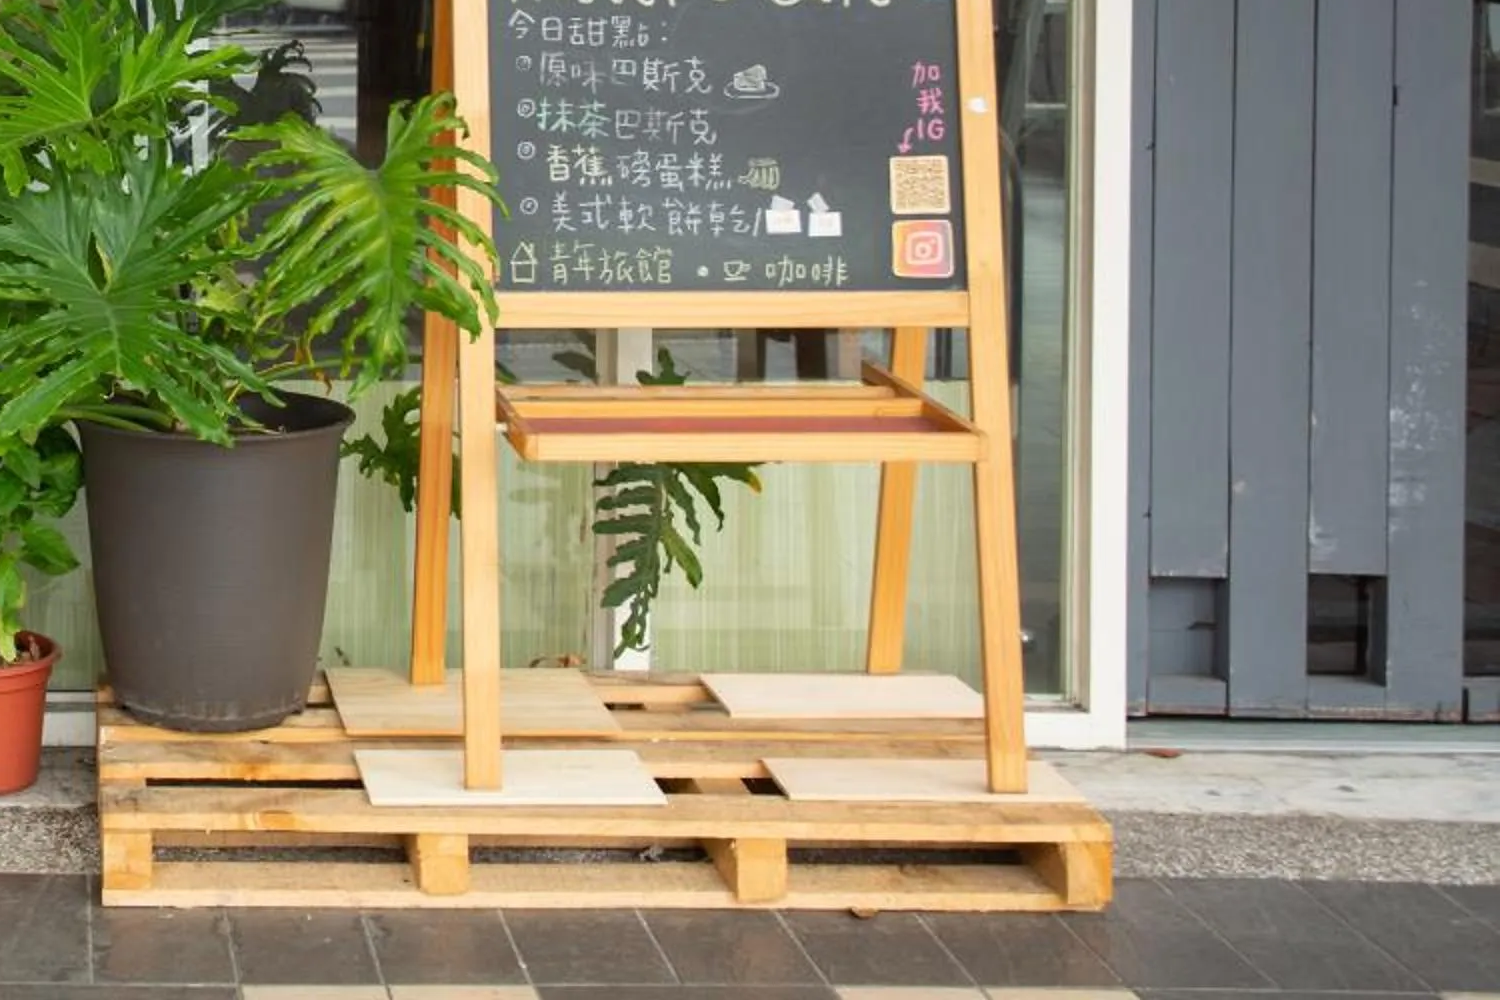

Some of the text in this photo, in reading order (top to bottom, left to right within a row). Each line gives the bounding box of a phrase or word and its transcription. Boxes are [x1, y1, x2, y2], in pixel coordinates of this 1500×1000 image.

[539, 50, 713, 95] 原味巴斯克
[535, 96, 718, 146] 抹茶巴斯克
[546, 143, 732, 193] 香蕉磅蛋糕
[549, 239, 849, 287] 青年旅館 咖啡
